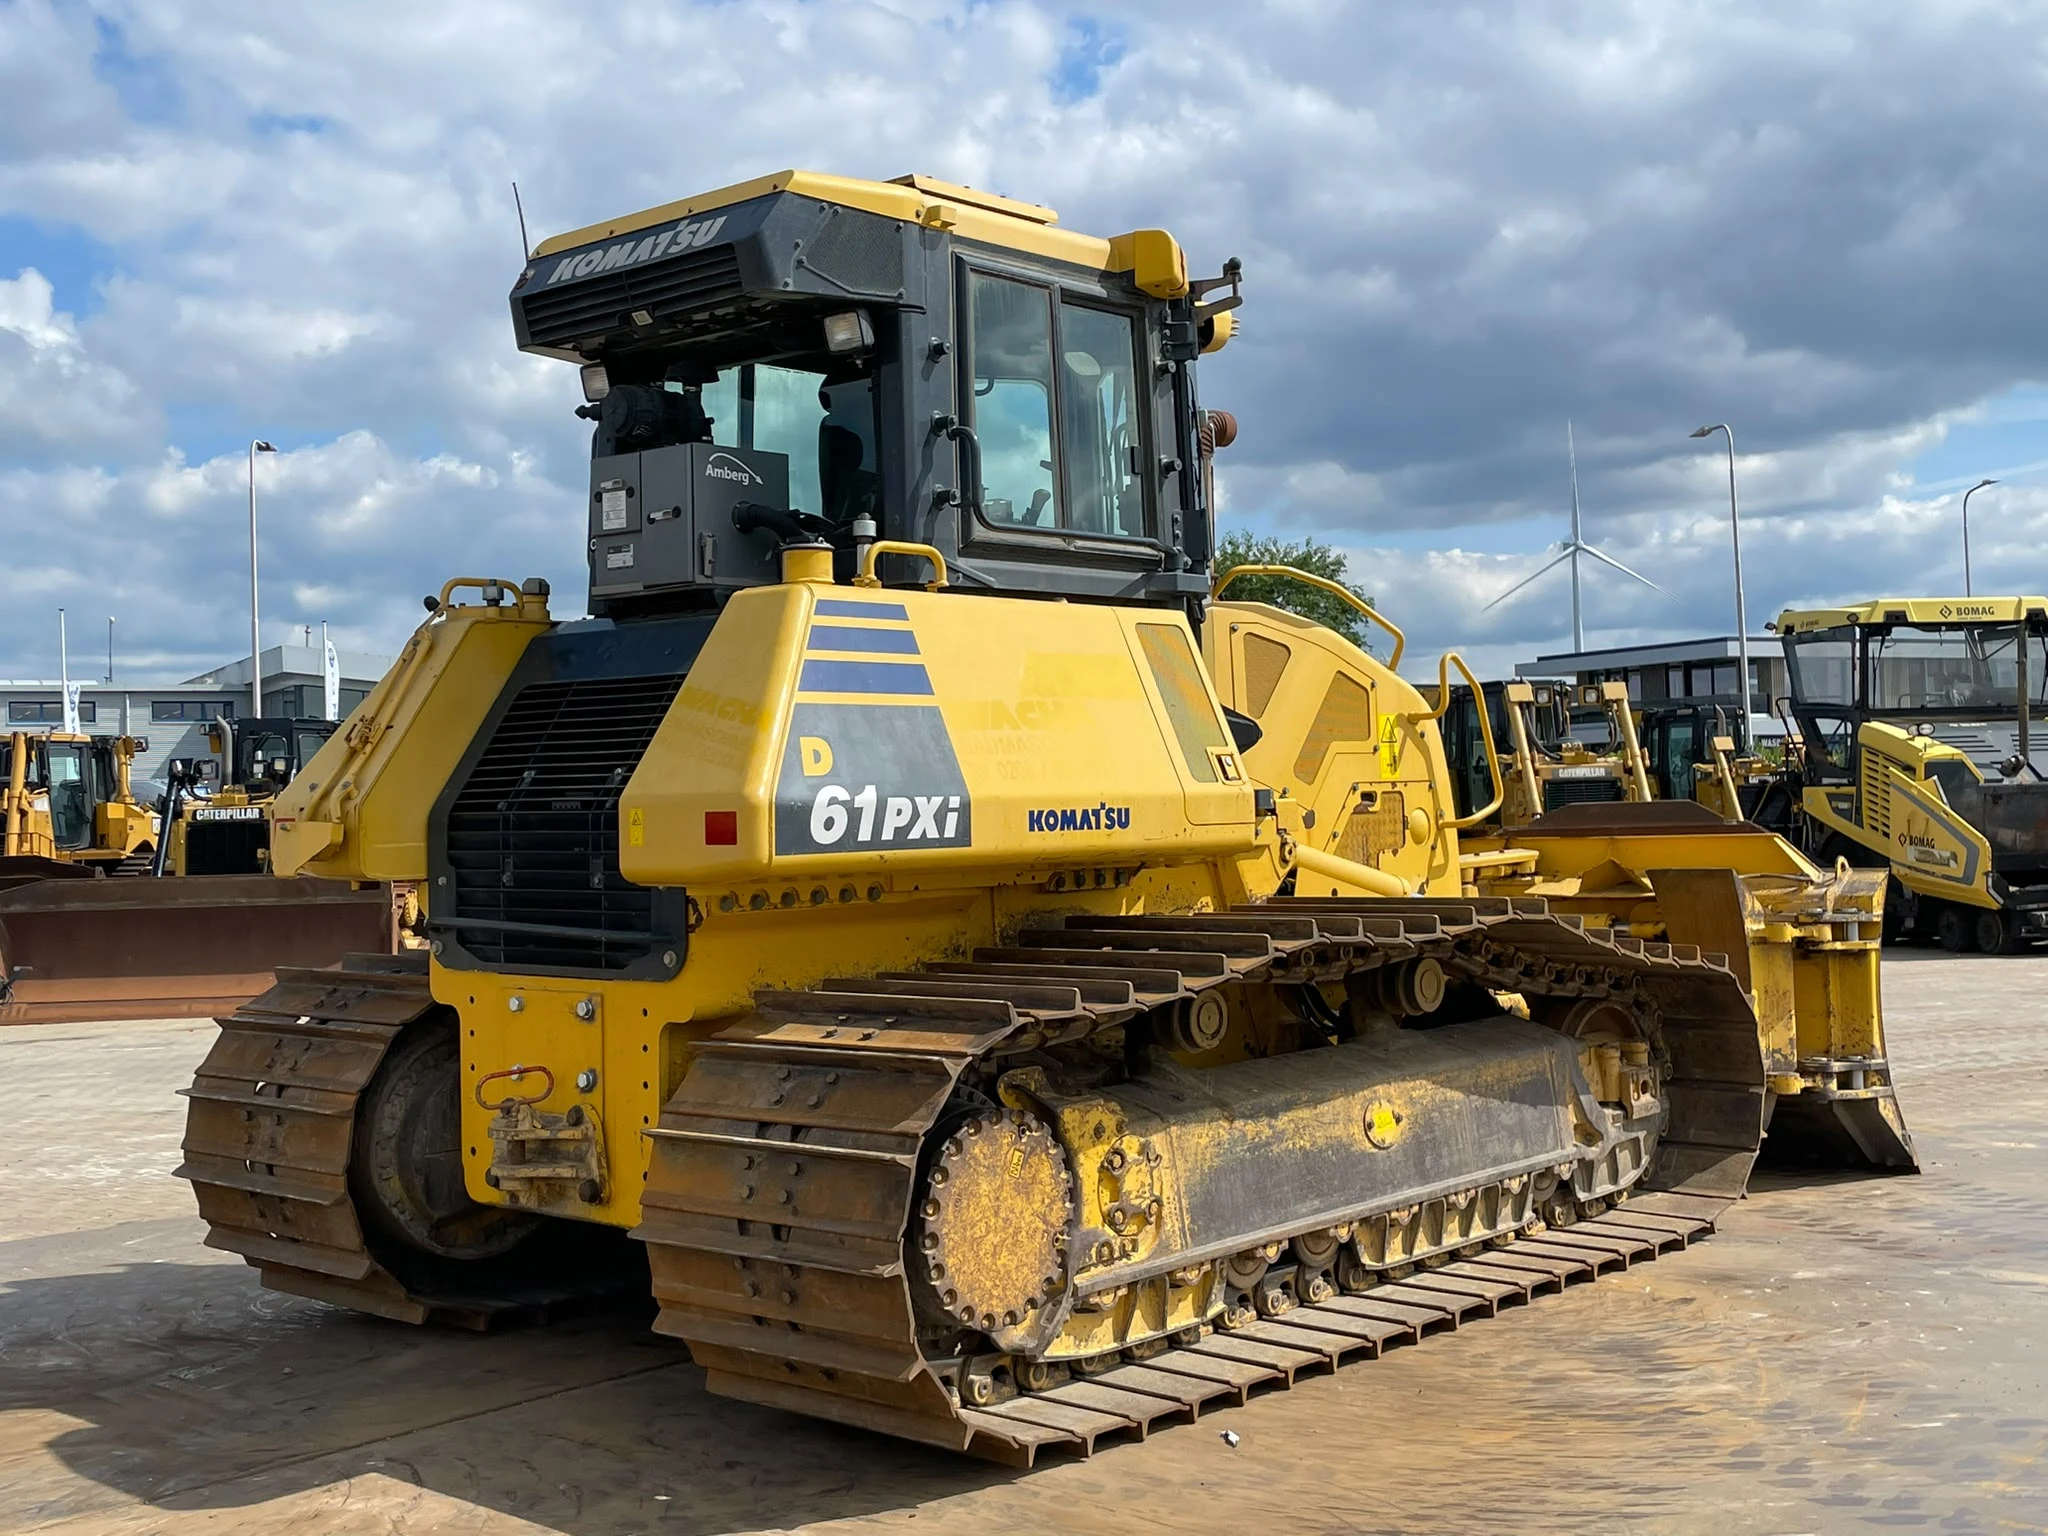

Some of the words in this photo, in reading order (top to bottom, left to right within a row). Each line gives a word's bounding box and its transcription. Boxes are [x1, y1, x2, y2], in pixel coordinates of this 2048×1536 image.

[547, 215, 728, 285] KOMATSU
[705, 463, 750, 486] Amberg
[1956, 606, 1995, 616] BOMAG
[800, 736, 834, 777] D
[1558, 767, 1606, 778] CATERPILLAR
[196, 807, 260, 821] CATERPILLAR
[1028, 801, 1130, 832] KOMATSU
[1909, 834, 1936, 849] BOMAG
